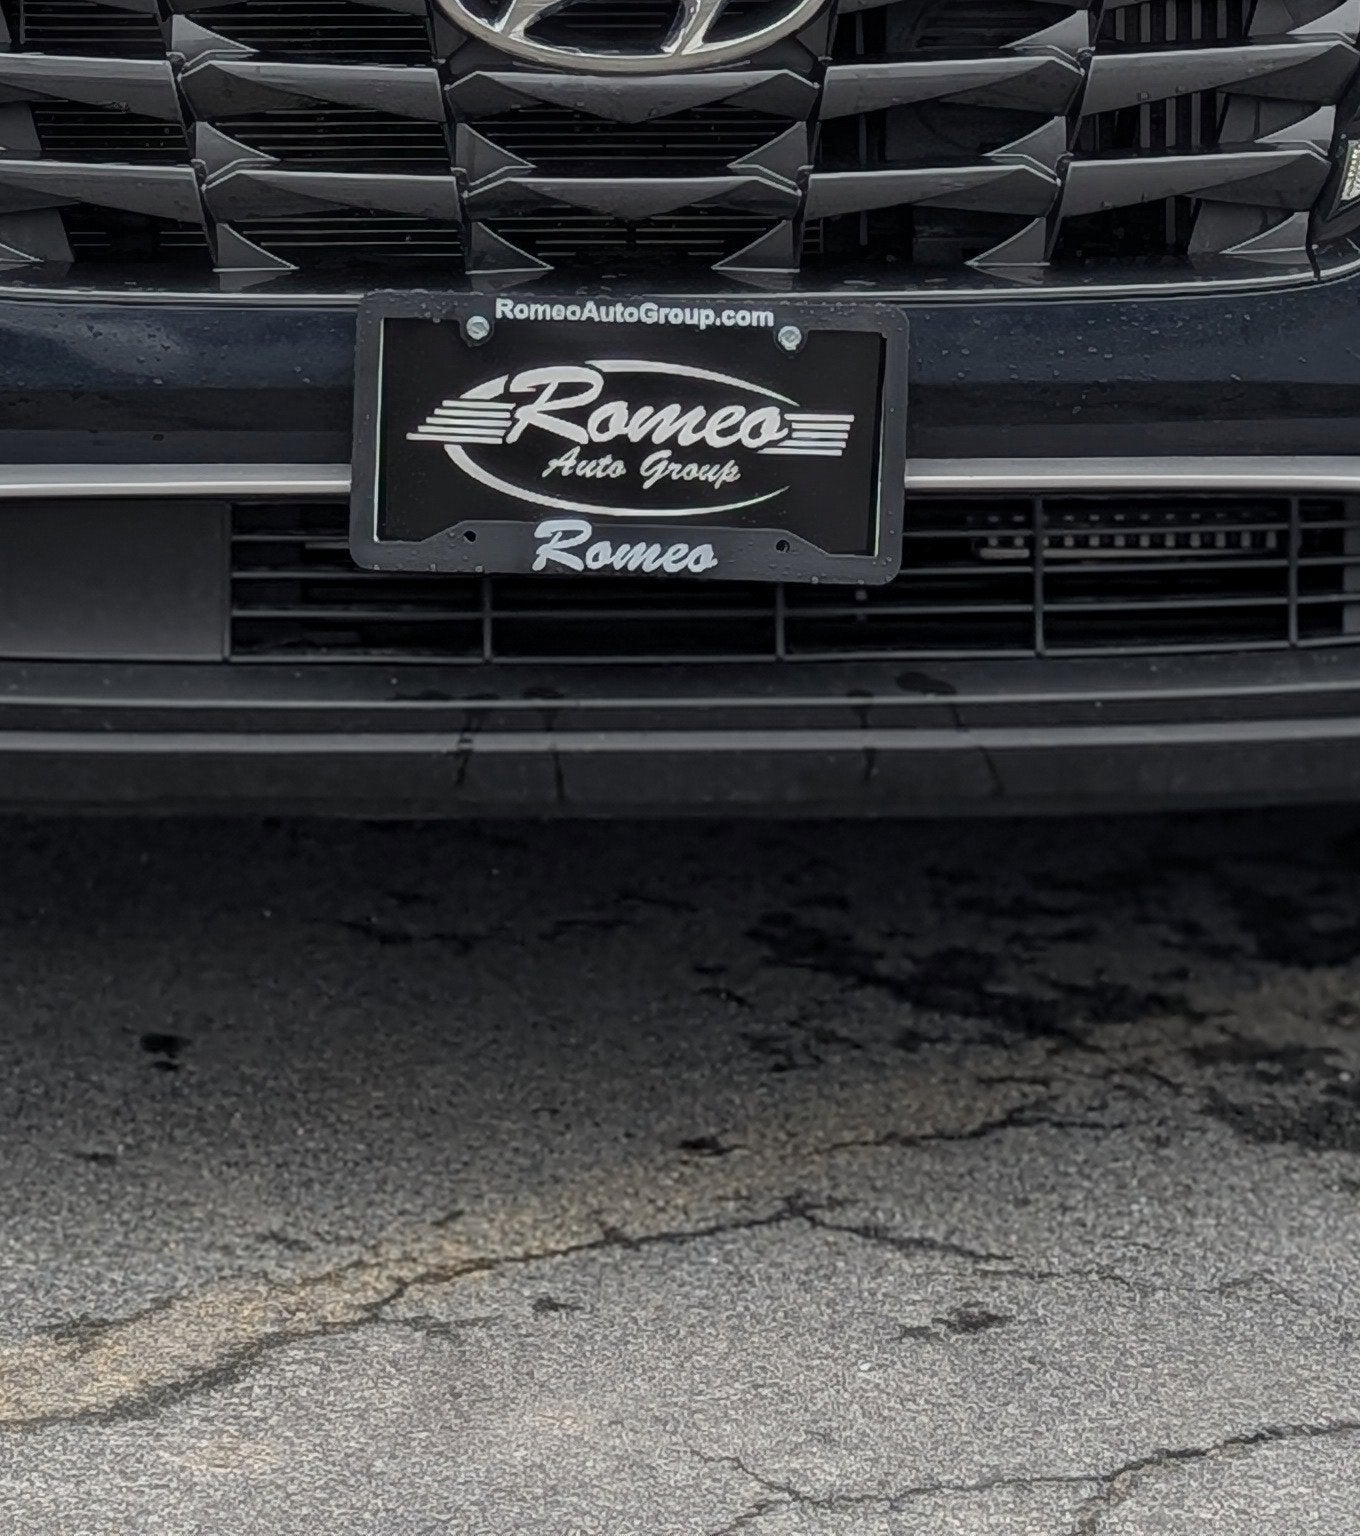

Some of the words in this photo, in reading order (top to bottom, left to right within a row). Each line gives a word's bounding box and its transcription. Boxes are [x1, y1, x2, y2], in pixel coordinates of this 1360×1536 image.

[495, 298, 774, 328] RomeoAutoGroup.com
[506, 365, 790, 448] Romeo
[542, 446, 627, 479] Auto
[640, 449, 741, 489] Group
[531, 519, 718, 572] Romeo
